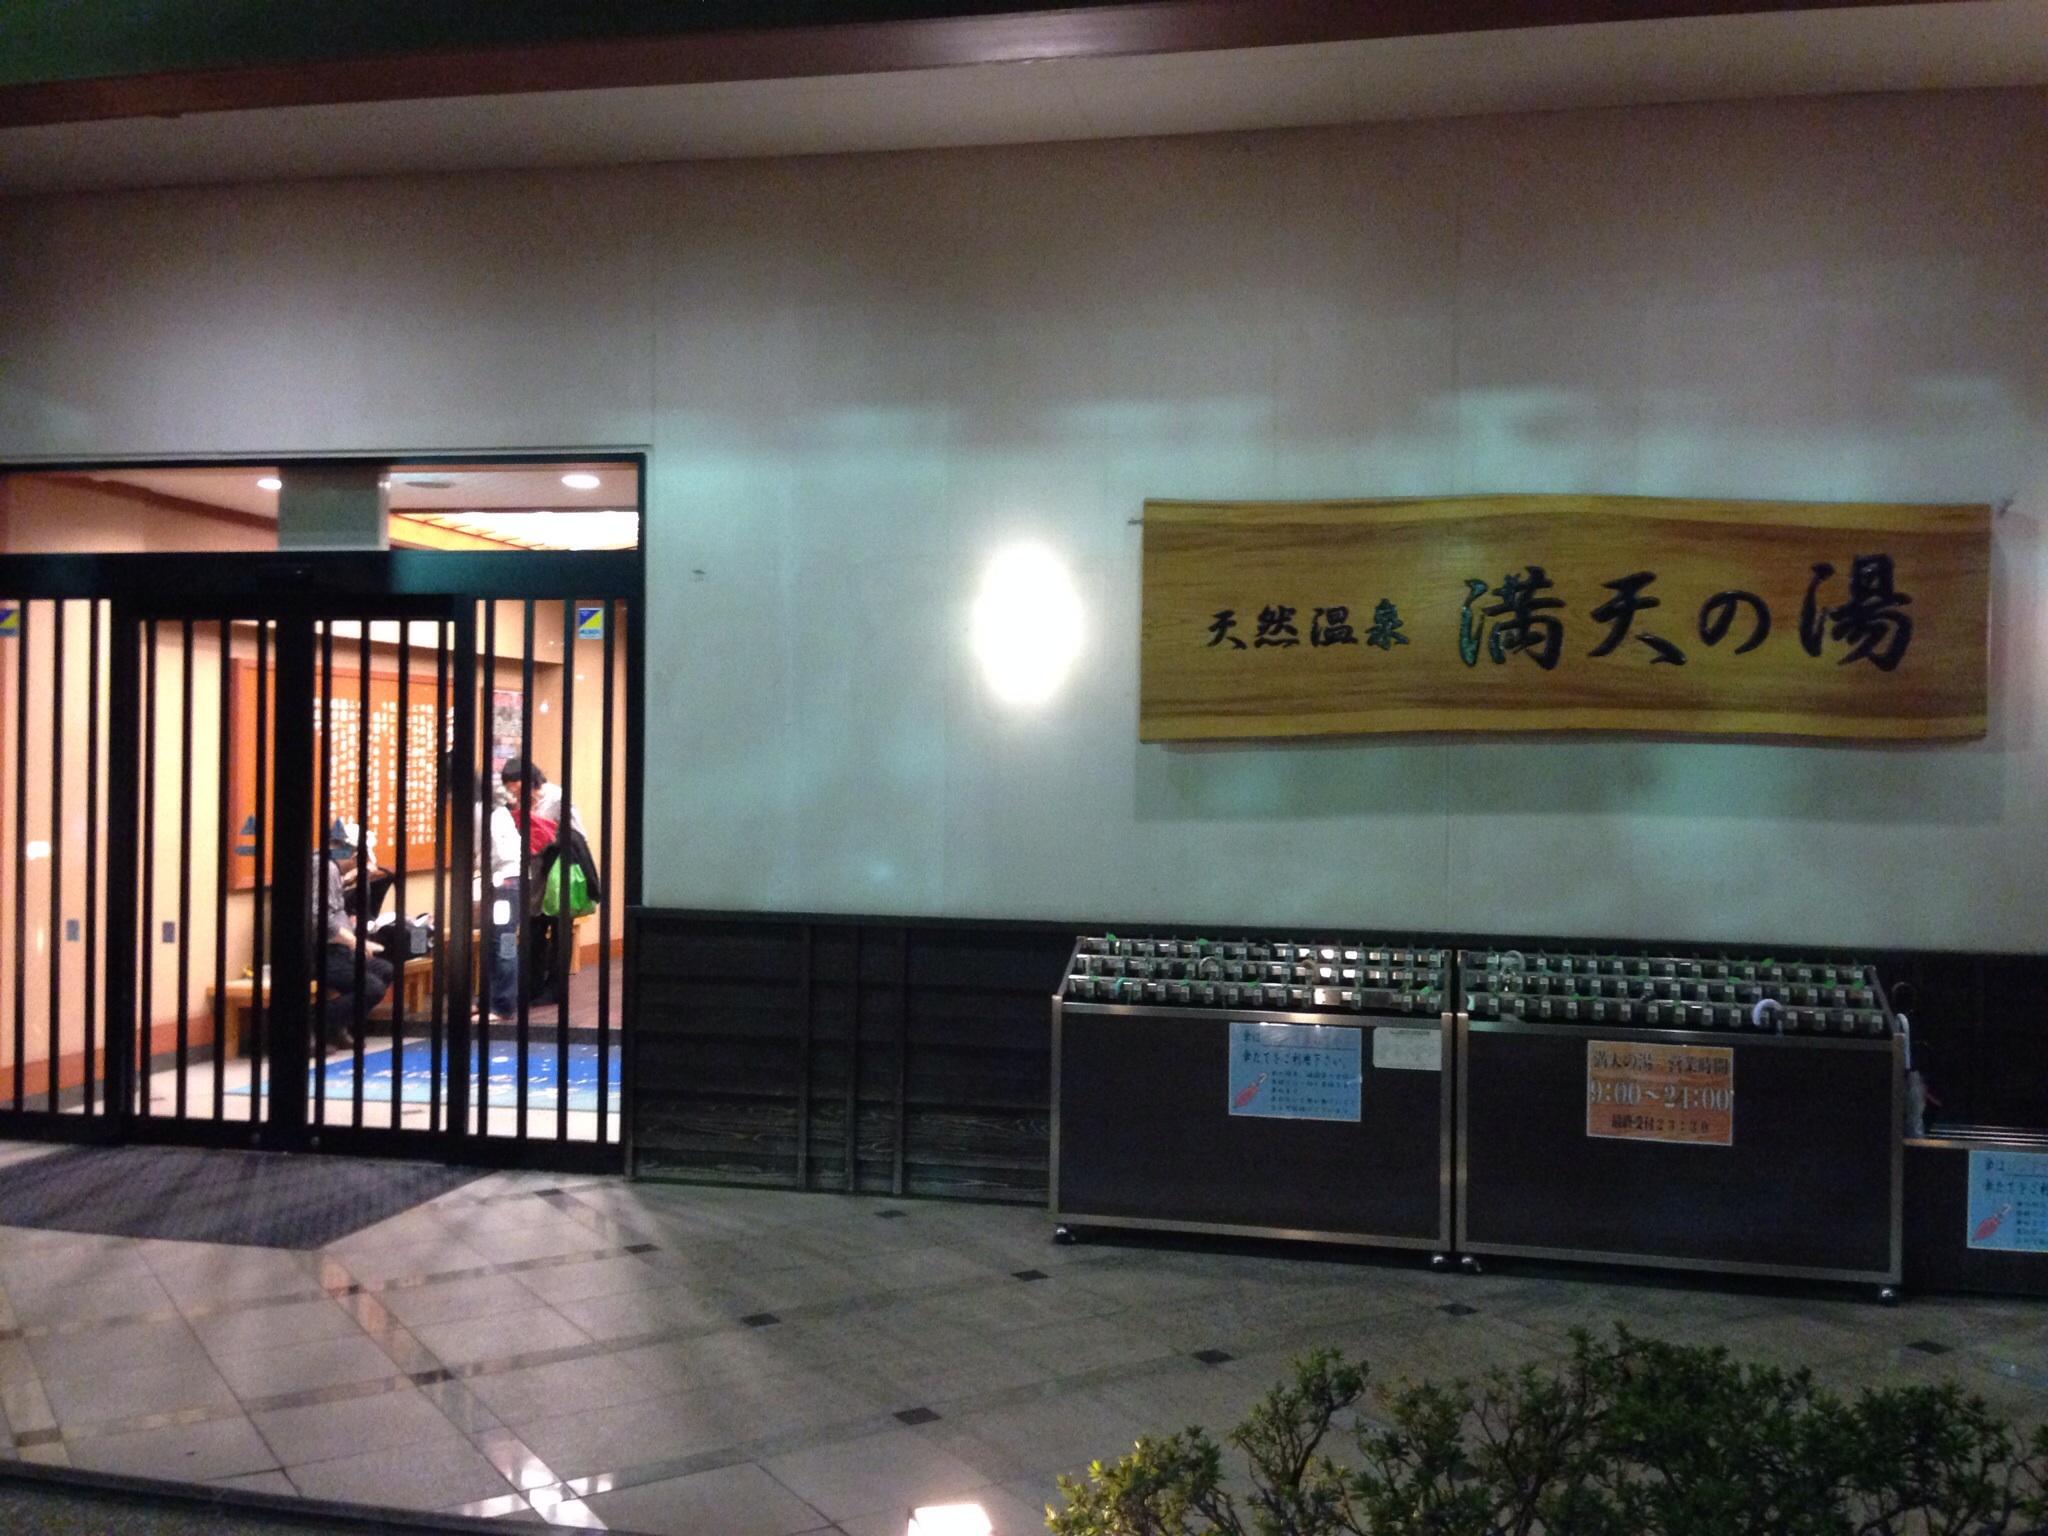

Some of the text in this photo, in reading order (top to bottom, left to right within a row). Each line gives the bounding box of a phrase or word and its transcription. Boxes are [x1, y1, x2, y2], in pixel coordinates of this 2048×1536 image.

[1207, 553, 1915, 671] 天然温泉 満天の湯
